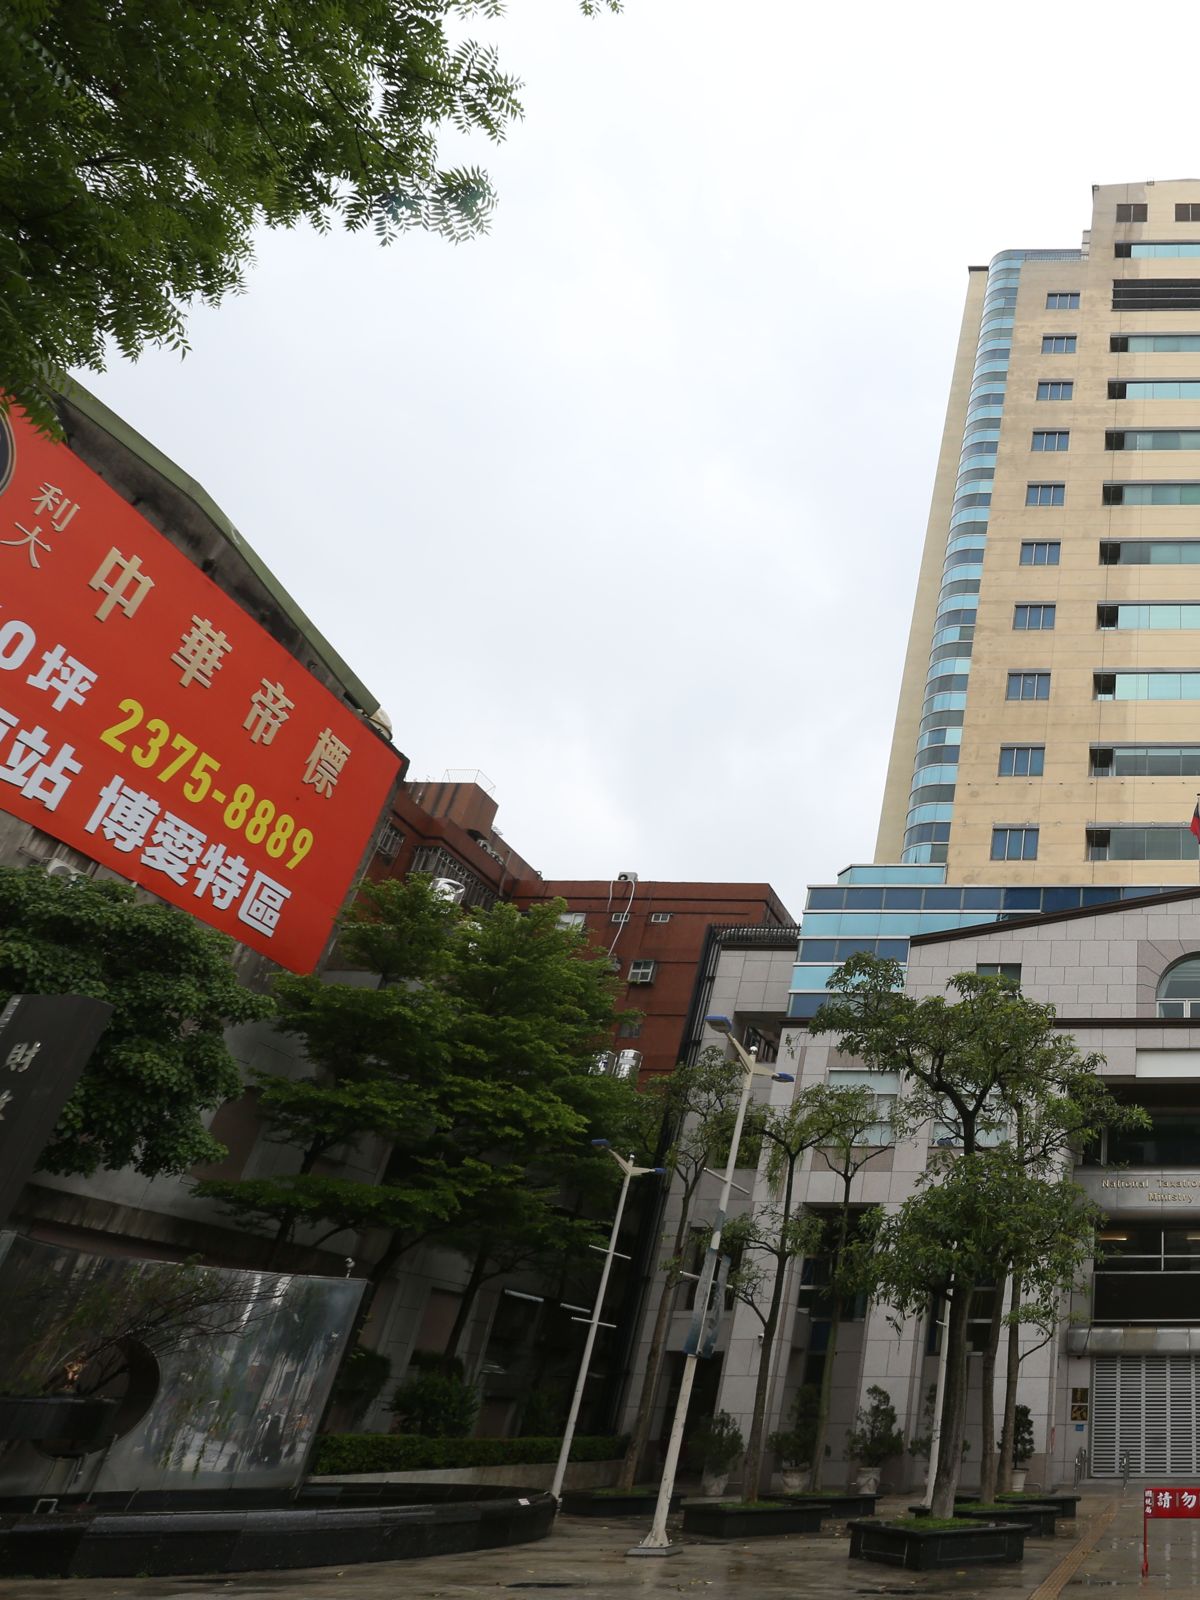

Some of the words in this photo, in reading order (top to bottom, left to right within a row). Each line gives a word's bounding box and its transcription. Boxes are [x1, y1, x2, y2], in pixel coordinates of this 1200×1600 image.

[88, 546, 352, 799] 中華帝標
[84, 774, 292, 938] 博愛特區
[100, 698, 314, 870] 2375-8889
[1102, 1179, 1150, 1189] National
[1148, 1192, 1194, 1203] Ministry
